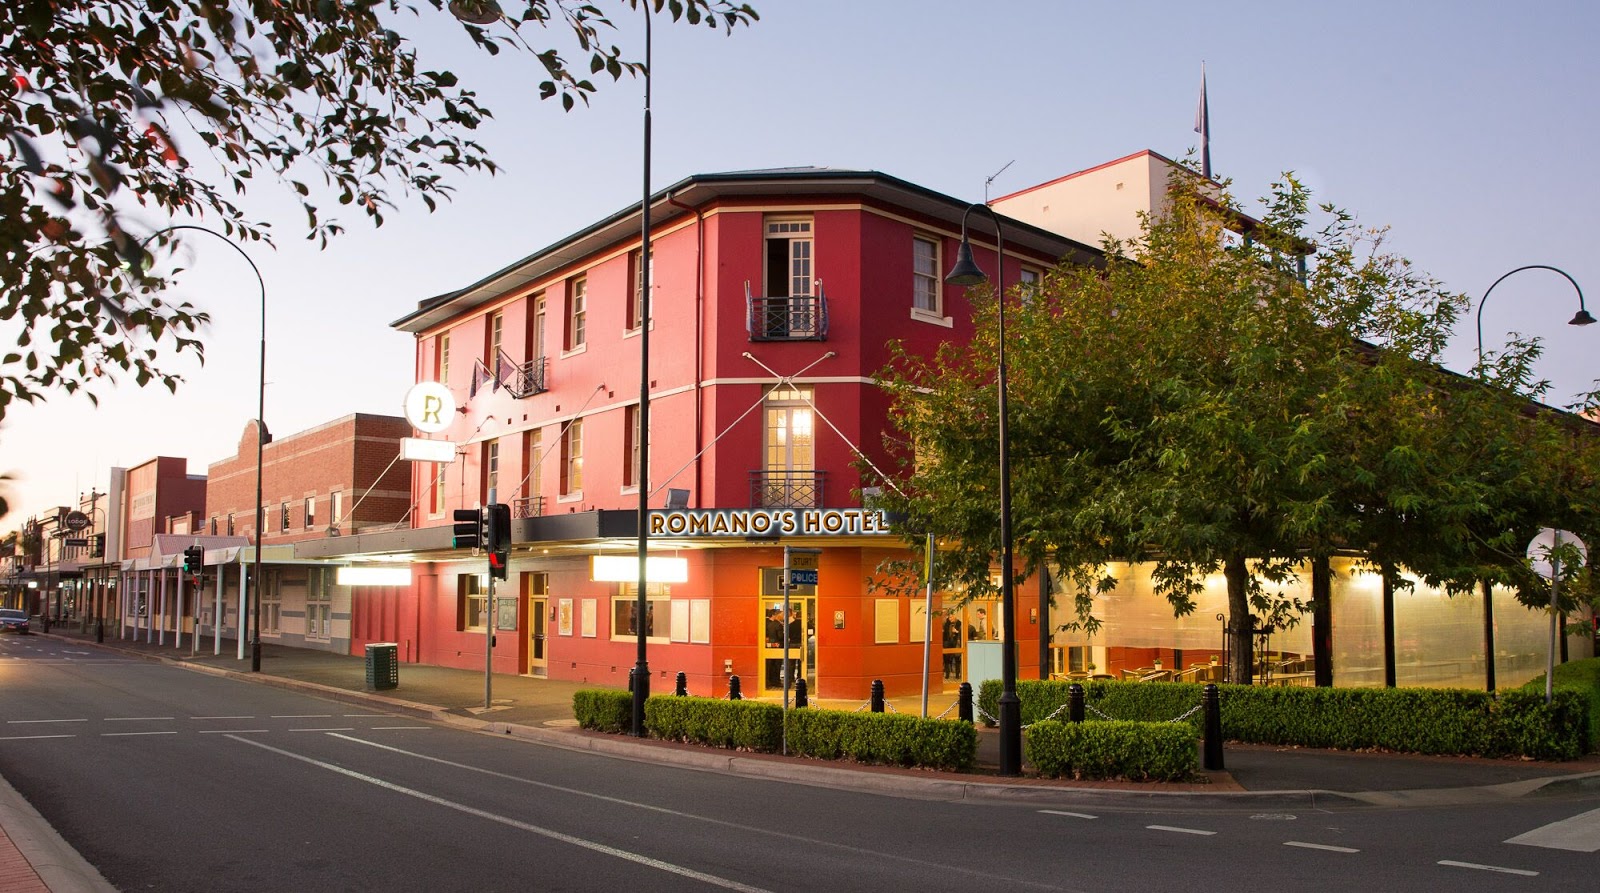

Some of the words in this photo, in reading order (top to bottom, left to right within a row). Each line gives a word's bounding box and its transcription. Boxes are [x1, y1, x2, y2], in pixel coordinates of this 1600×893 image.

[421, 394, 442, 424] R
[650, 510, 795, 534] ROMANO'S
[804, 509, 891, 534] HOTEL
[793, 557, 812, 566] STURT
[791, 572, 818, 582] POLICE
